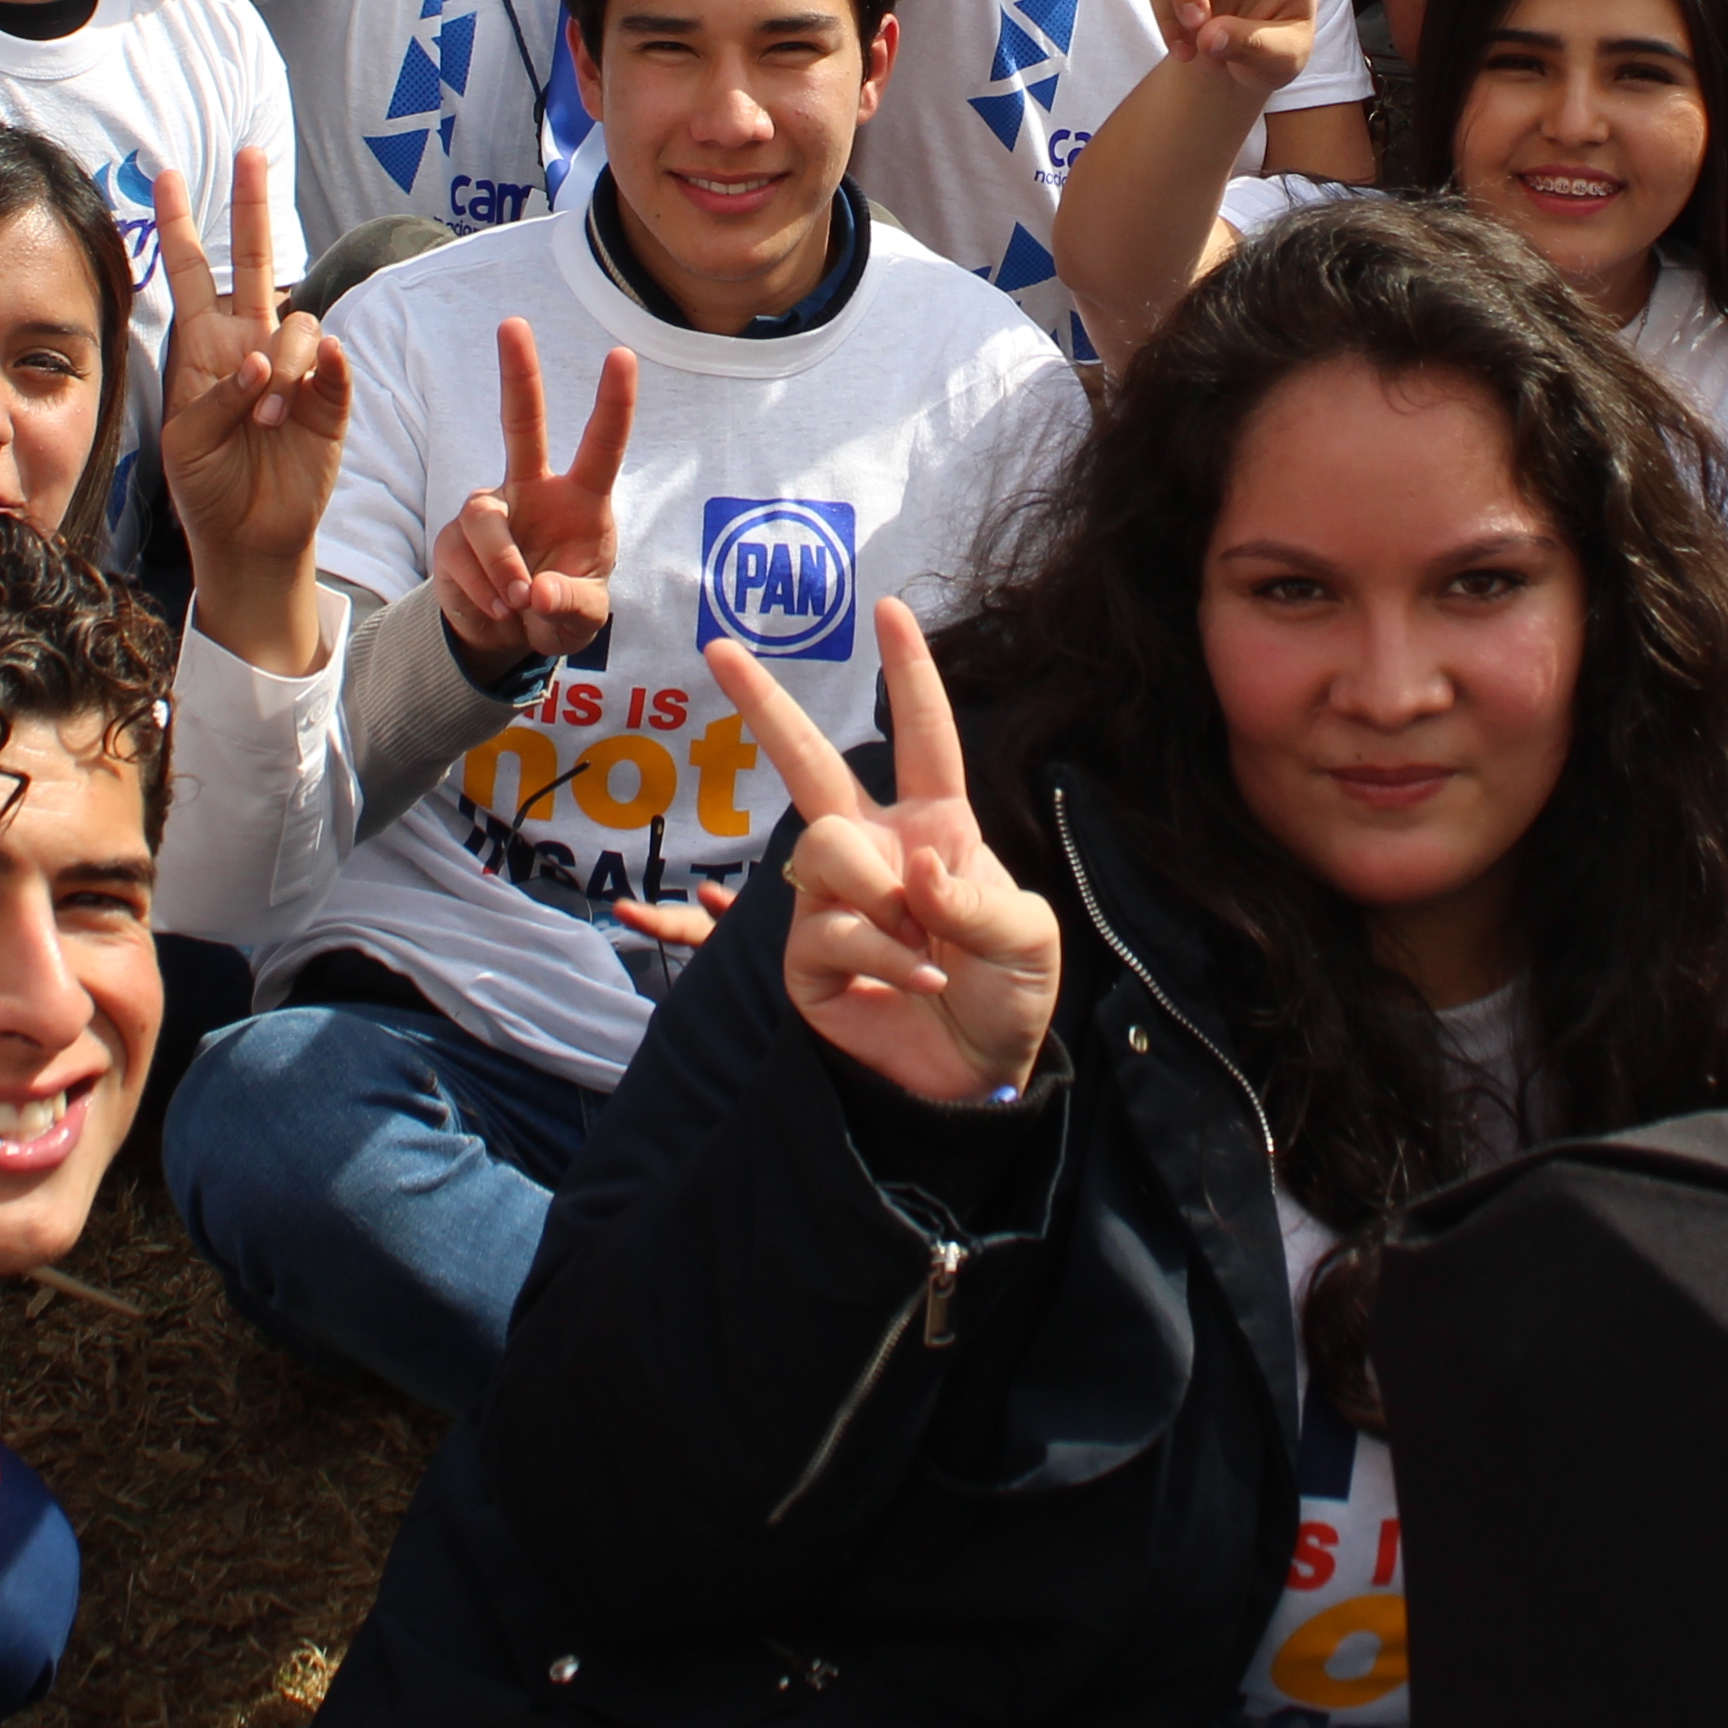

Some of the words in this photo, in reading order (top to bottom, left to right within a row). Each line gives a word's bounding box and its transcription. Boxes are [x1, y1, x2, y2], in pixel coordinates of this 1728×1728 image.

[451, 175, 535, 224] cam
[733, 542, 827, 616] PAN
[626, 688, 689, 731] IS
[463, 713, 758, 837] not
